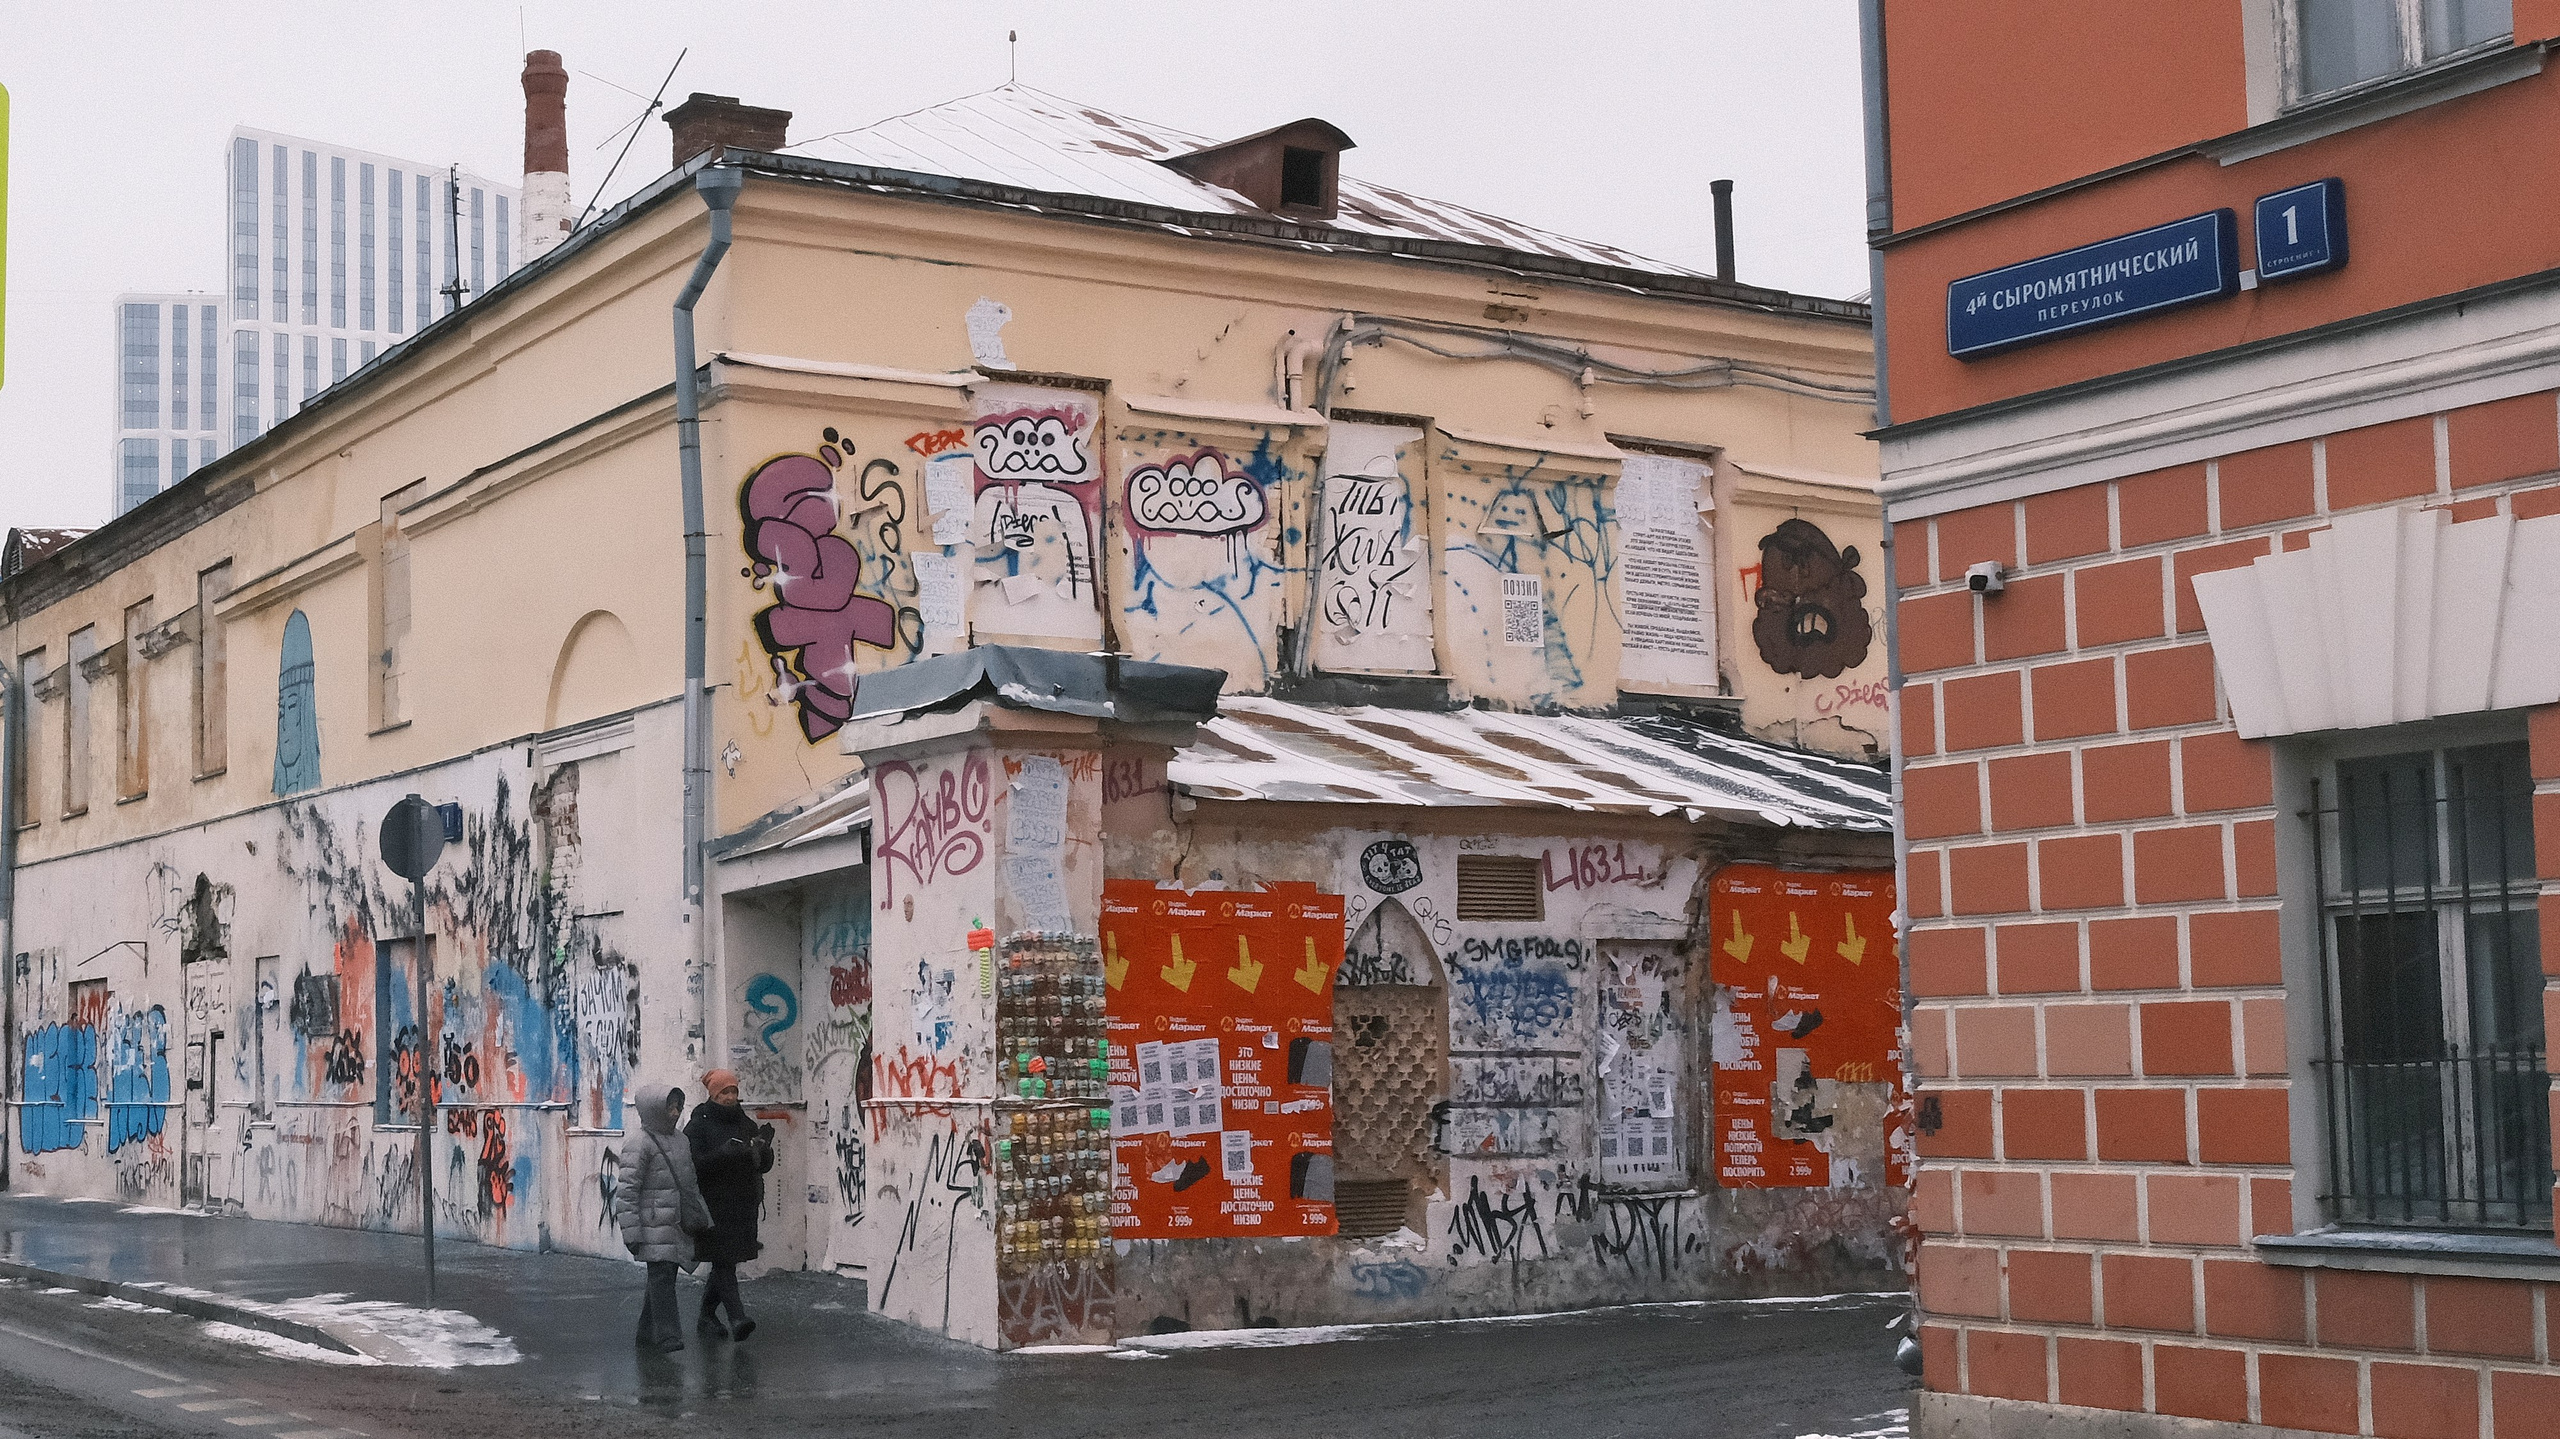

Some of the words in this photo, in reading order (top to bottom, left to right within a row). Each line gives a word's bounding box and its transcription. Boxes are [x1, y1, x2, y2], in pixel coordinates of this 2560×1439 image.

[2282, 205, 2298, 245] 1
[1966, 292, 1987, 316] 4й
[1992, 237, 2199, 311] СЫРОМЯТНИЧЕСКИЙ
[2038, 290, 2125, 322] ПЕРЕУЛОК
[1364, 844, 1378, 860] TIT
[1390, 846, 1411, 857] TAT
[1167, 908, 1206, 917] Маркет
[1235, 909, 1273, 918] Маркет
[1301, 911, 1339, 920] Маркет
[1169, 1023, 1206, 1032] Маркет
[1235, 1024, 1273, 1033] Маркет
[1301, 1025, 1333, 1034] Марке
[1238, 1047, 1253, 1058] ЭТО
[1230, 1060, 1262, 1071] НИЗКИЕ
[1107, 1070, 1137, 1083] ПРОБУЙ
[1232, 1073, 1259, 1085] ЦЕНЫ,
[1221, 1086, 1272, 1099] ДОСТАТОЧНО
[1232, 1099, 1259, 1110] НИЗКО
[1170, 1139, 1207, 1148] Маркет
[1250, 1139, 1274, 1148] ркет
[1302, 1139, 1333, 1148] Марке
[1730, 1155, 1757, 1165] ТЕПЕРЬ
[1112, 1187, 1139, 1200] РОБУЙ
[1233, 1188, 1261, 1200] ЦЕНЫ,
[1111, 1202, 1132, 1214] ПЕРЬ
[1220, 1201, 1275, 1214] ДОСТАТОЧНО
[1110, 1215, 1141, 1227] ПОРИТЬ
[1233, 1213, 1262, 1225] НИЗКО
